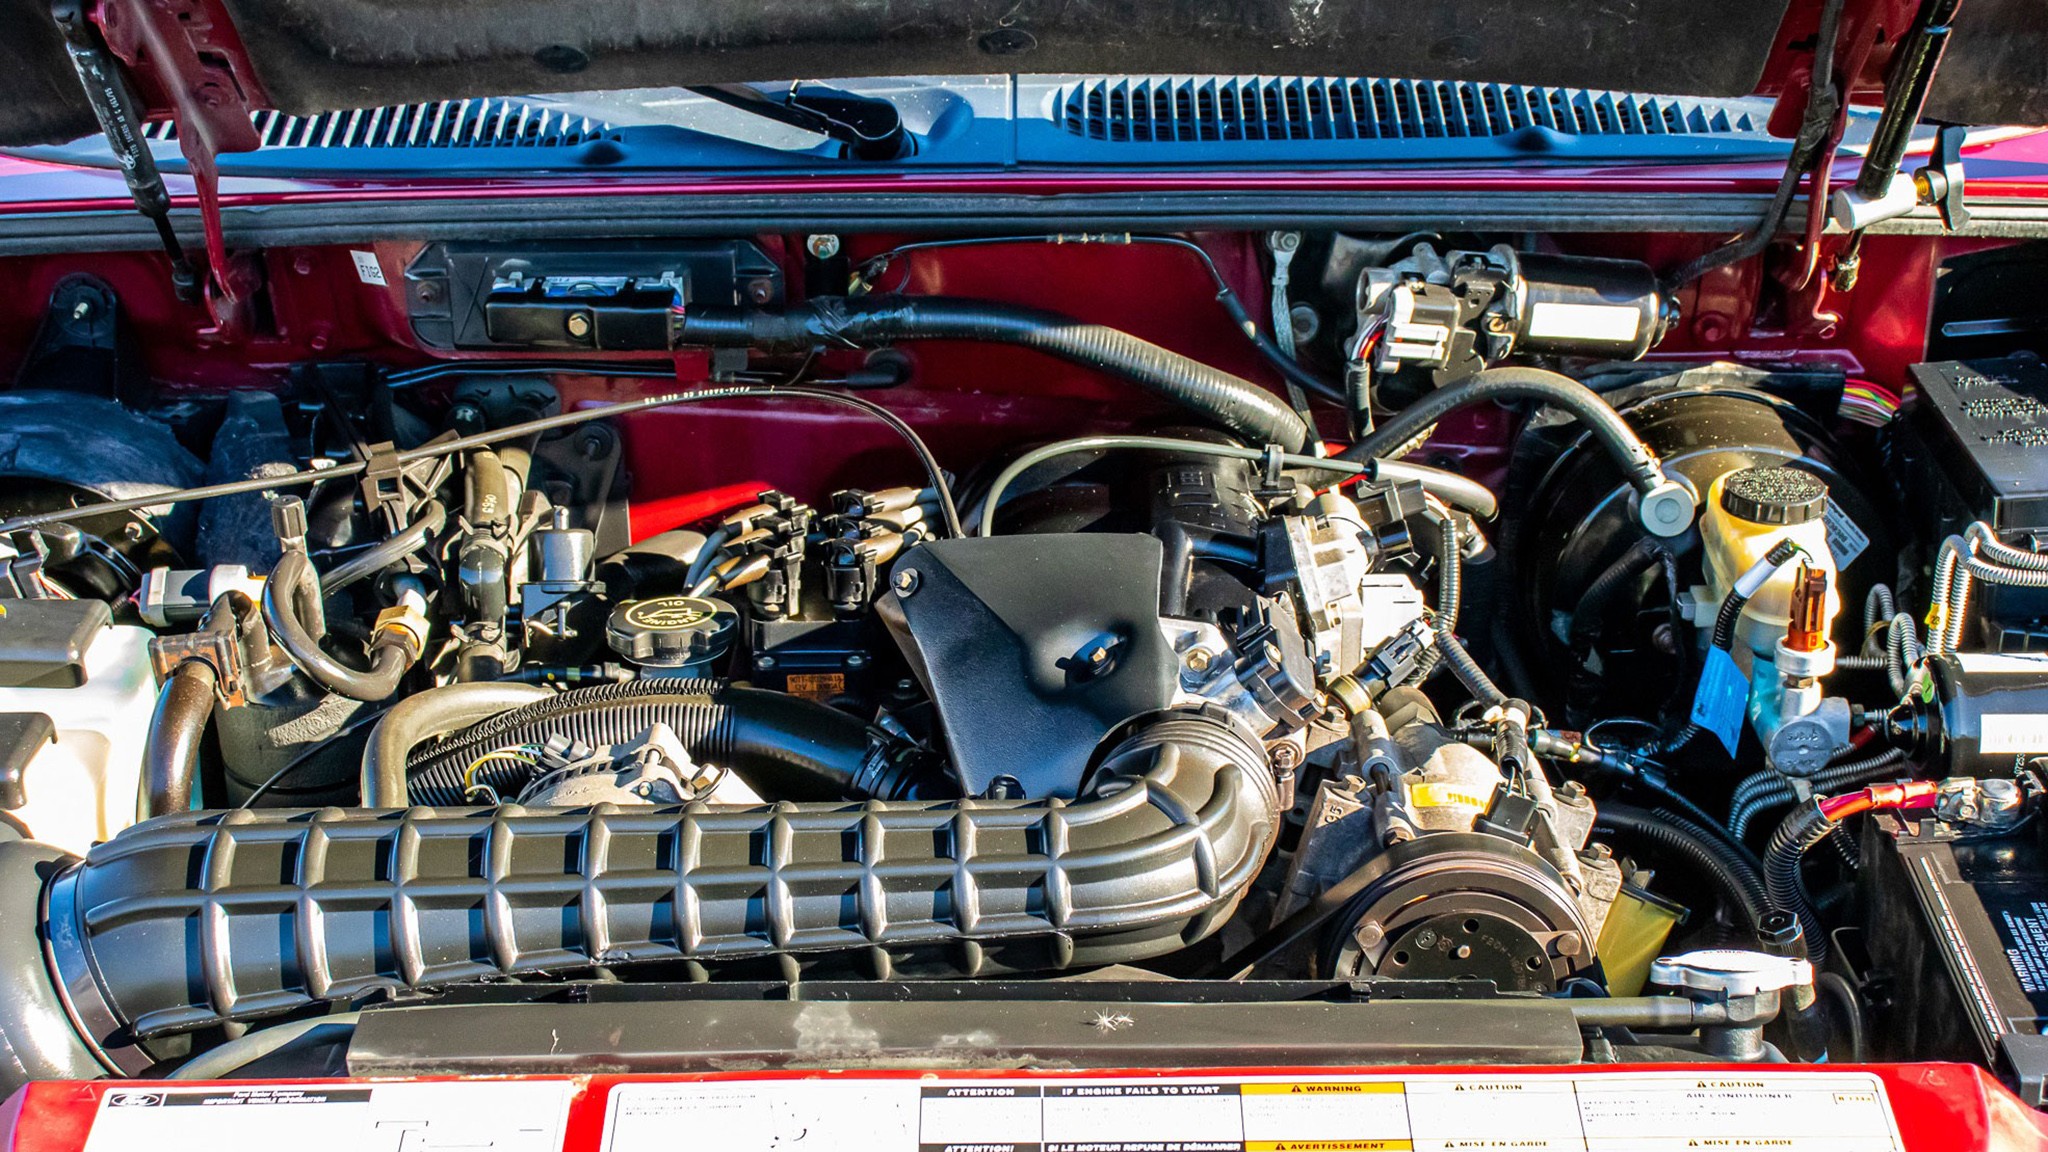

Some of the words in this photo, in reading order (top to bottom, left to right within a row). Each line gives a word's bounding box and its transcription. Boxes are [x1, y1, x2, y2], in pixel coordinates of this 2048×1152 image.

[642, 616, 698, 625] ENGINE
[2006, 948, 2038, 993] WARNING
[947, 1088, 1015, 1096] ATTENTION
[1062, 1088, 1073, 1096] IF
[1077, 1087, 1122, 1095] ENGINE
[1125, 1087, 1159, 1095] FAILS
[1182, 1086, 1221, 1094] START
